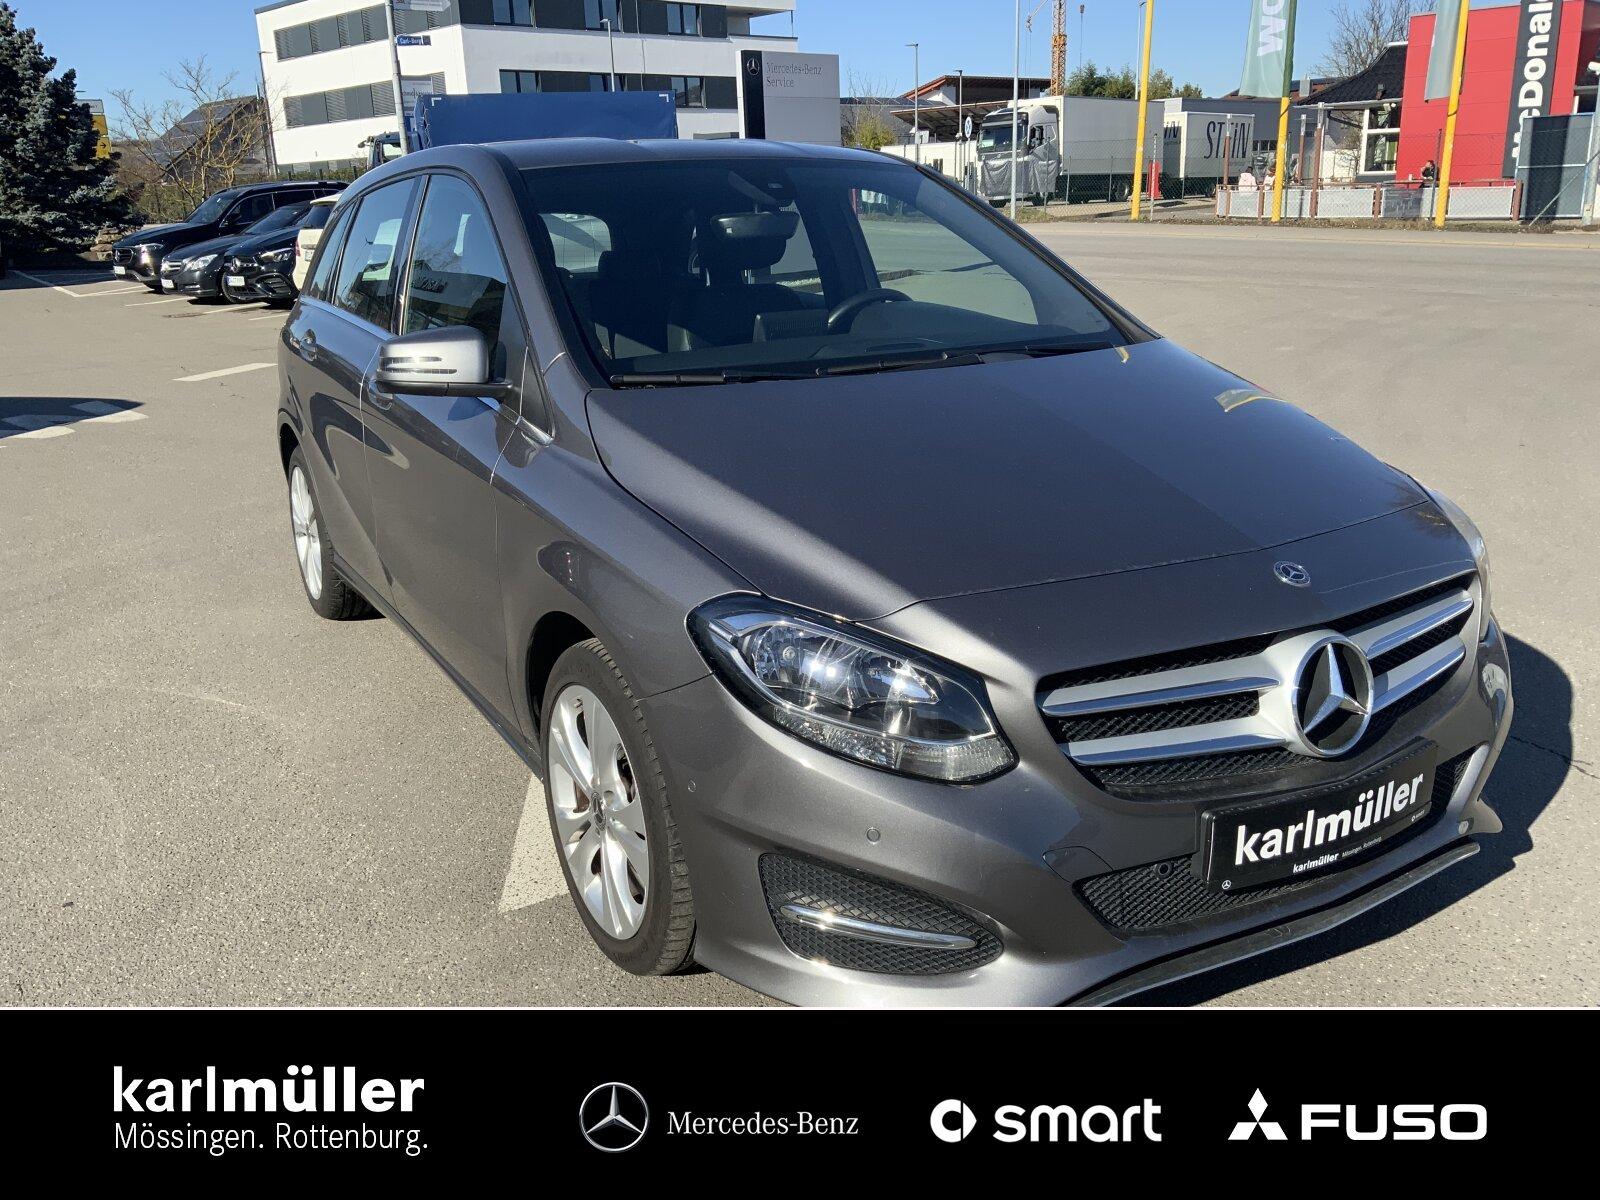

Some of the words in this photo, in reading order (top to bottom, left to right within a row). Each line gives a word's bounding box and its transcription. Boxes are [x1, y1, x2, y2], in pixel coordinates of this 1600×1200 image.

[766, 62, 822, 75] Mercedes-Benz
[766, 77, 795, 88] Service
[1235, 773, 1424, 866] karlmüller
[1293, 853, 1340, 874] karlmüller
